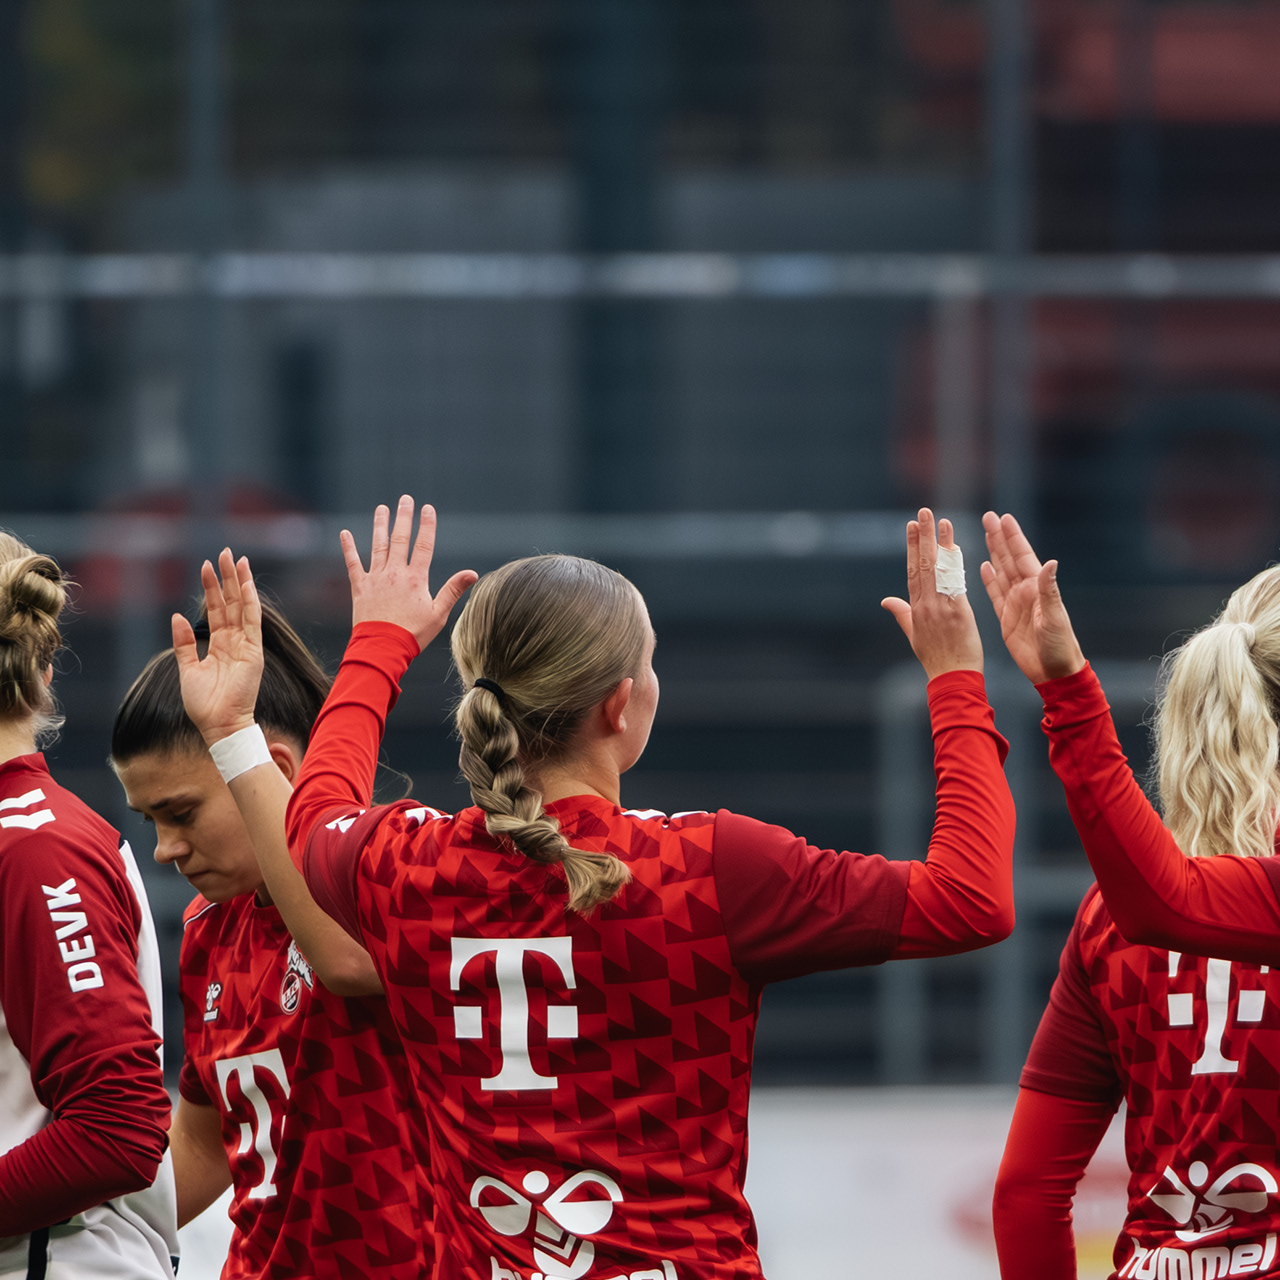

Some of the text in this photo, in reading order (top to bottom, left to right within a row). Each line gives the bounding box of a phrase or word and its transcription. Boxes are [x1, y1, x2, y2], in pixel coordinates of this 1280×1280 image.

[41, 878, 105, 993] DEVK
[450, 936, 578, 1091] T
[215, 1048, 291, 1199] T
